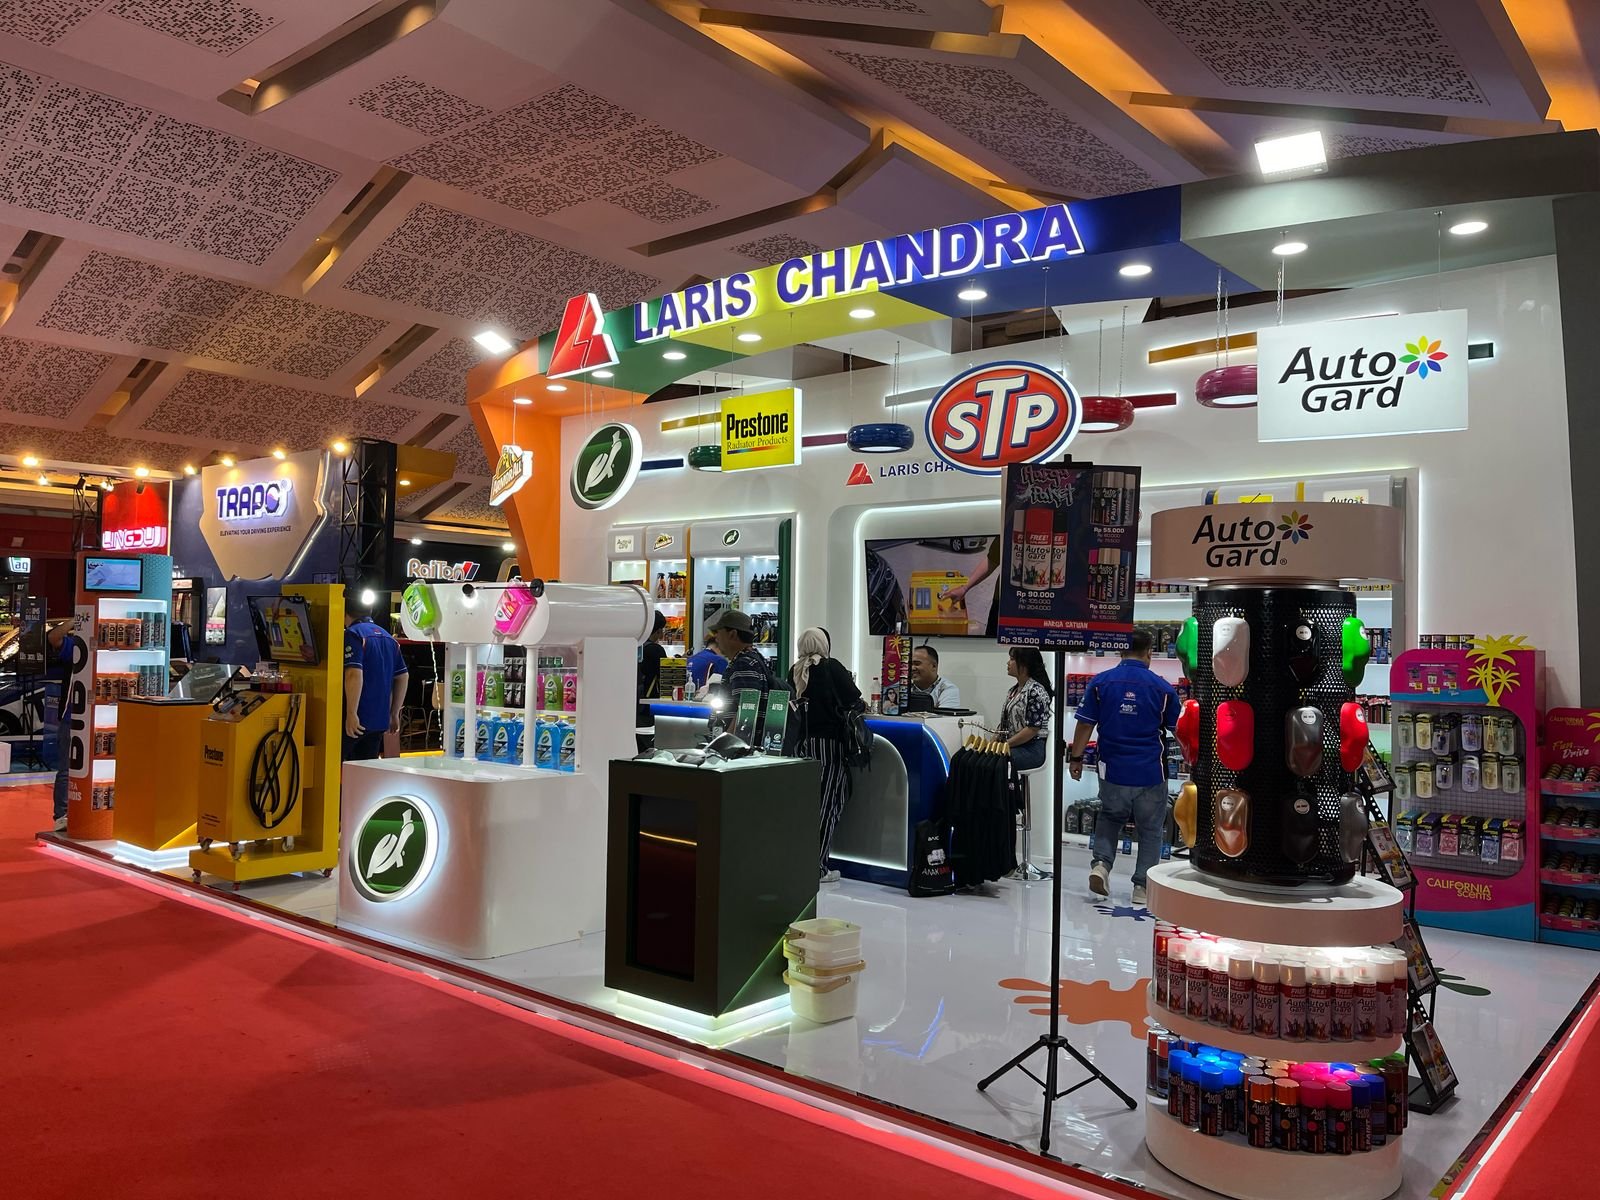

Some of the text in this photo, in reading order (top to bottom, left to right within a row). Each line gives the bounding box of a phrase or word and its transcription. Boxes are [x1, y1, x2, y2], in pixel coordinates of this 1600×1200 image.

[634, 203, 1084, 342] LARIS CHANDRA
[1278, 346, 1397, 384] Auto
[1301, 376, 1405, 413] Gard
[727, 412, 788, 440] Prestone
[943, 373, 1059, 460] STP
[727, 436, 788, 450] Radiator Products
[880, 463, 920, 477] LARIS
[217, 484, 281, 518] TRAPO
[267, 525, 291, 533] EXPERIENCE
[1192, 514, 1276, 544] Auto
[1016, 590, 1026, 598] Rp
[1000, 636, 1040, 645] Rp 35.000
[1089, 641, 1129, 649] Rp 20.000
[1426, 877, 1491, 894] CALIFORNIA
